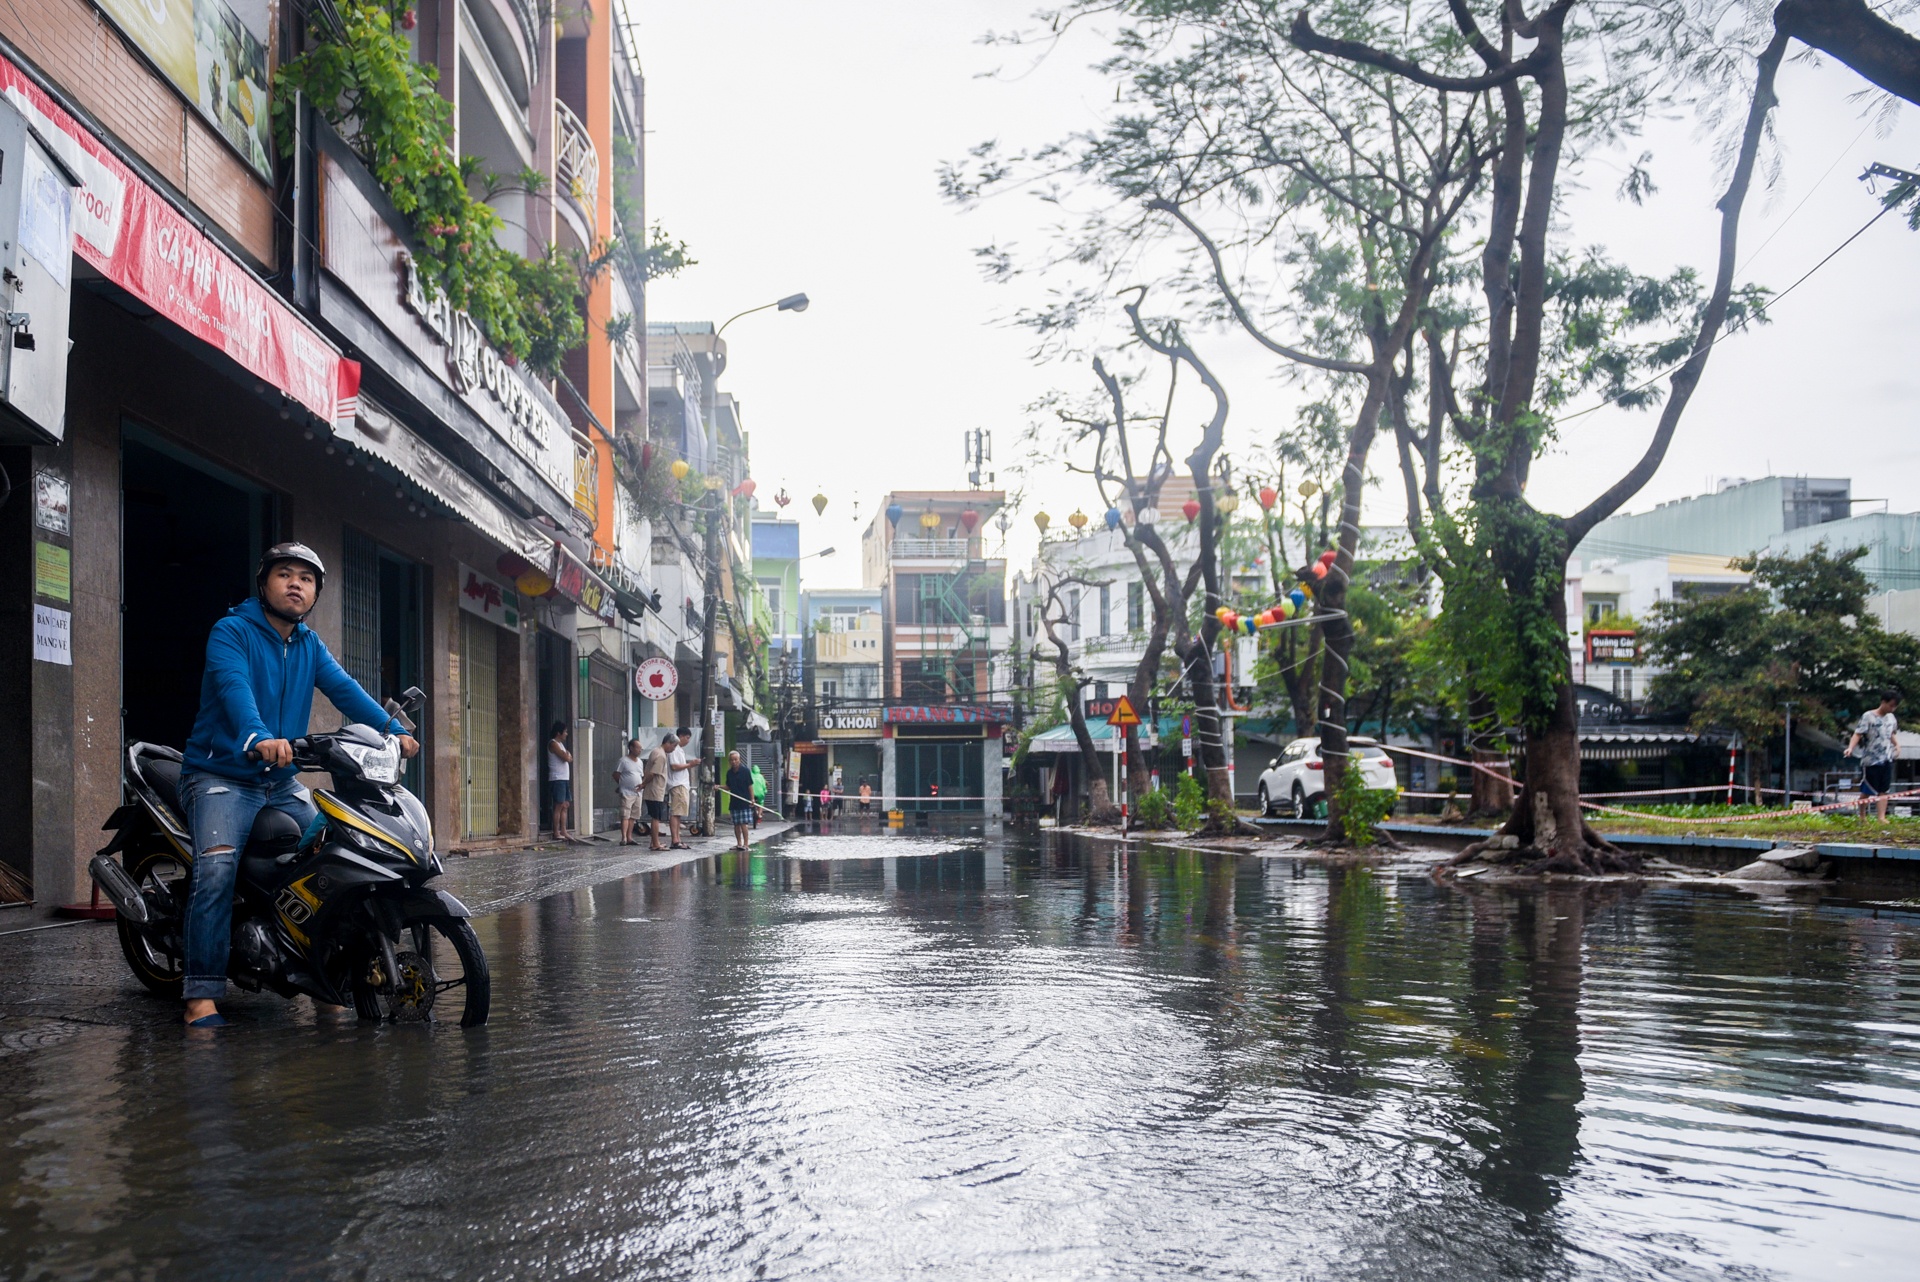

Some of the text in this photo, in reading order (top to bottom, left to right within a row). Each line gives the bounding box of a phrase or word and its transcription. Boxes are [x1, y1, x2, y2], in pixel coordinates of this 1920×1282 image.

[158, 227, 180, 270] CÀ
[182, 245, 213, 295] PHÊ
[247, 296, 270, 337] CAO
[176, 293, 184, 309] 22
[483, 346, 550, 452] COFFEE
[36, 634, 57, 649] MANG
[838, 717, 877, 729] KHOAI
[274, 888, 314, 924] 10
